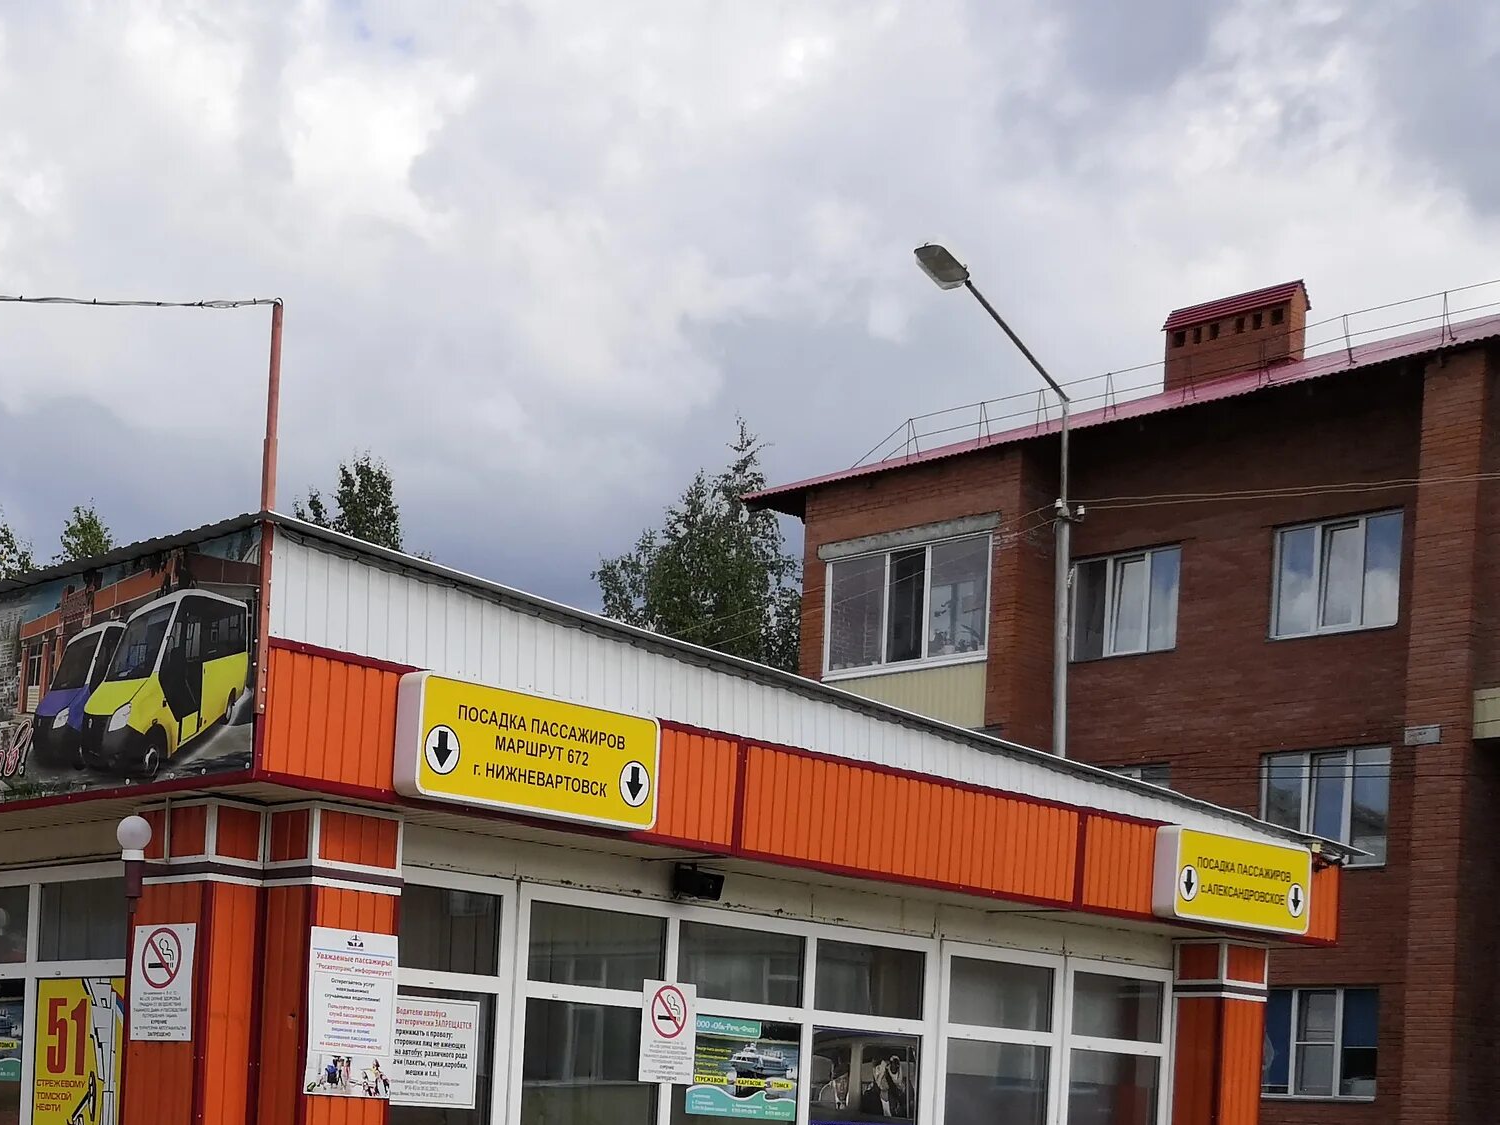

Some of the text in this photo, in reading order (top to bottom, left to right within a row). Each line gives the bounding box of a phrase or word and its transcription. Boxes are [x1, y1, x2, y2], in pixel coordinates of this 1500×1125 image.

[458, 704, 626, 750] ПОСАДКА ПАССАЖИРОВ
[495, 735, 589, 766] МАРШРУТ 672
[473, 762, 607, 797] г. НИЖНЕВАРТОВСК
[1197, 856, 1291, 883] ПОСАДКА ПАССАЖИРОВ
[316, 952, 393, 967] Уважаемые пассажиры!
[396, 1006, 447, 1019] Водителю автобуса
[435, 1019, 472, 1029] ЗАПРЕЩАЕТСЯ
[47, 997, 88, 1076] 51
[36, 1079, 86, 1089] СТРЕЖЕВОМУ
[36, 1090, 72, 1101] ТОМСКОЙ
[35, 1103, 61, 1113] НЕФТИ
